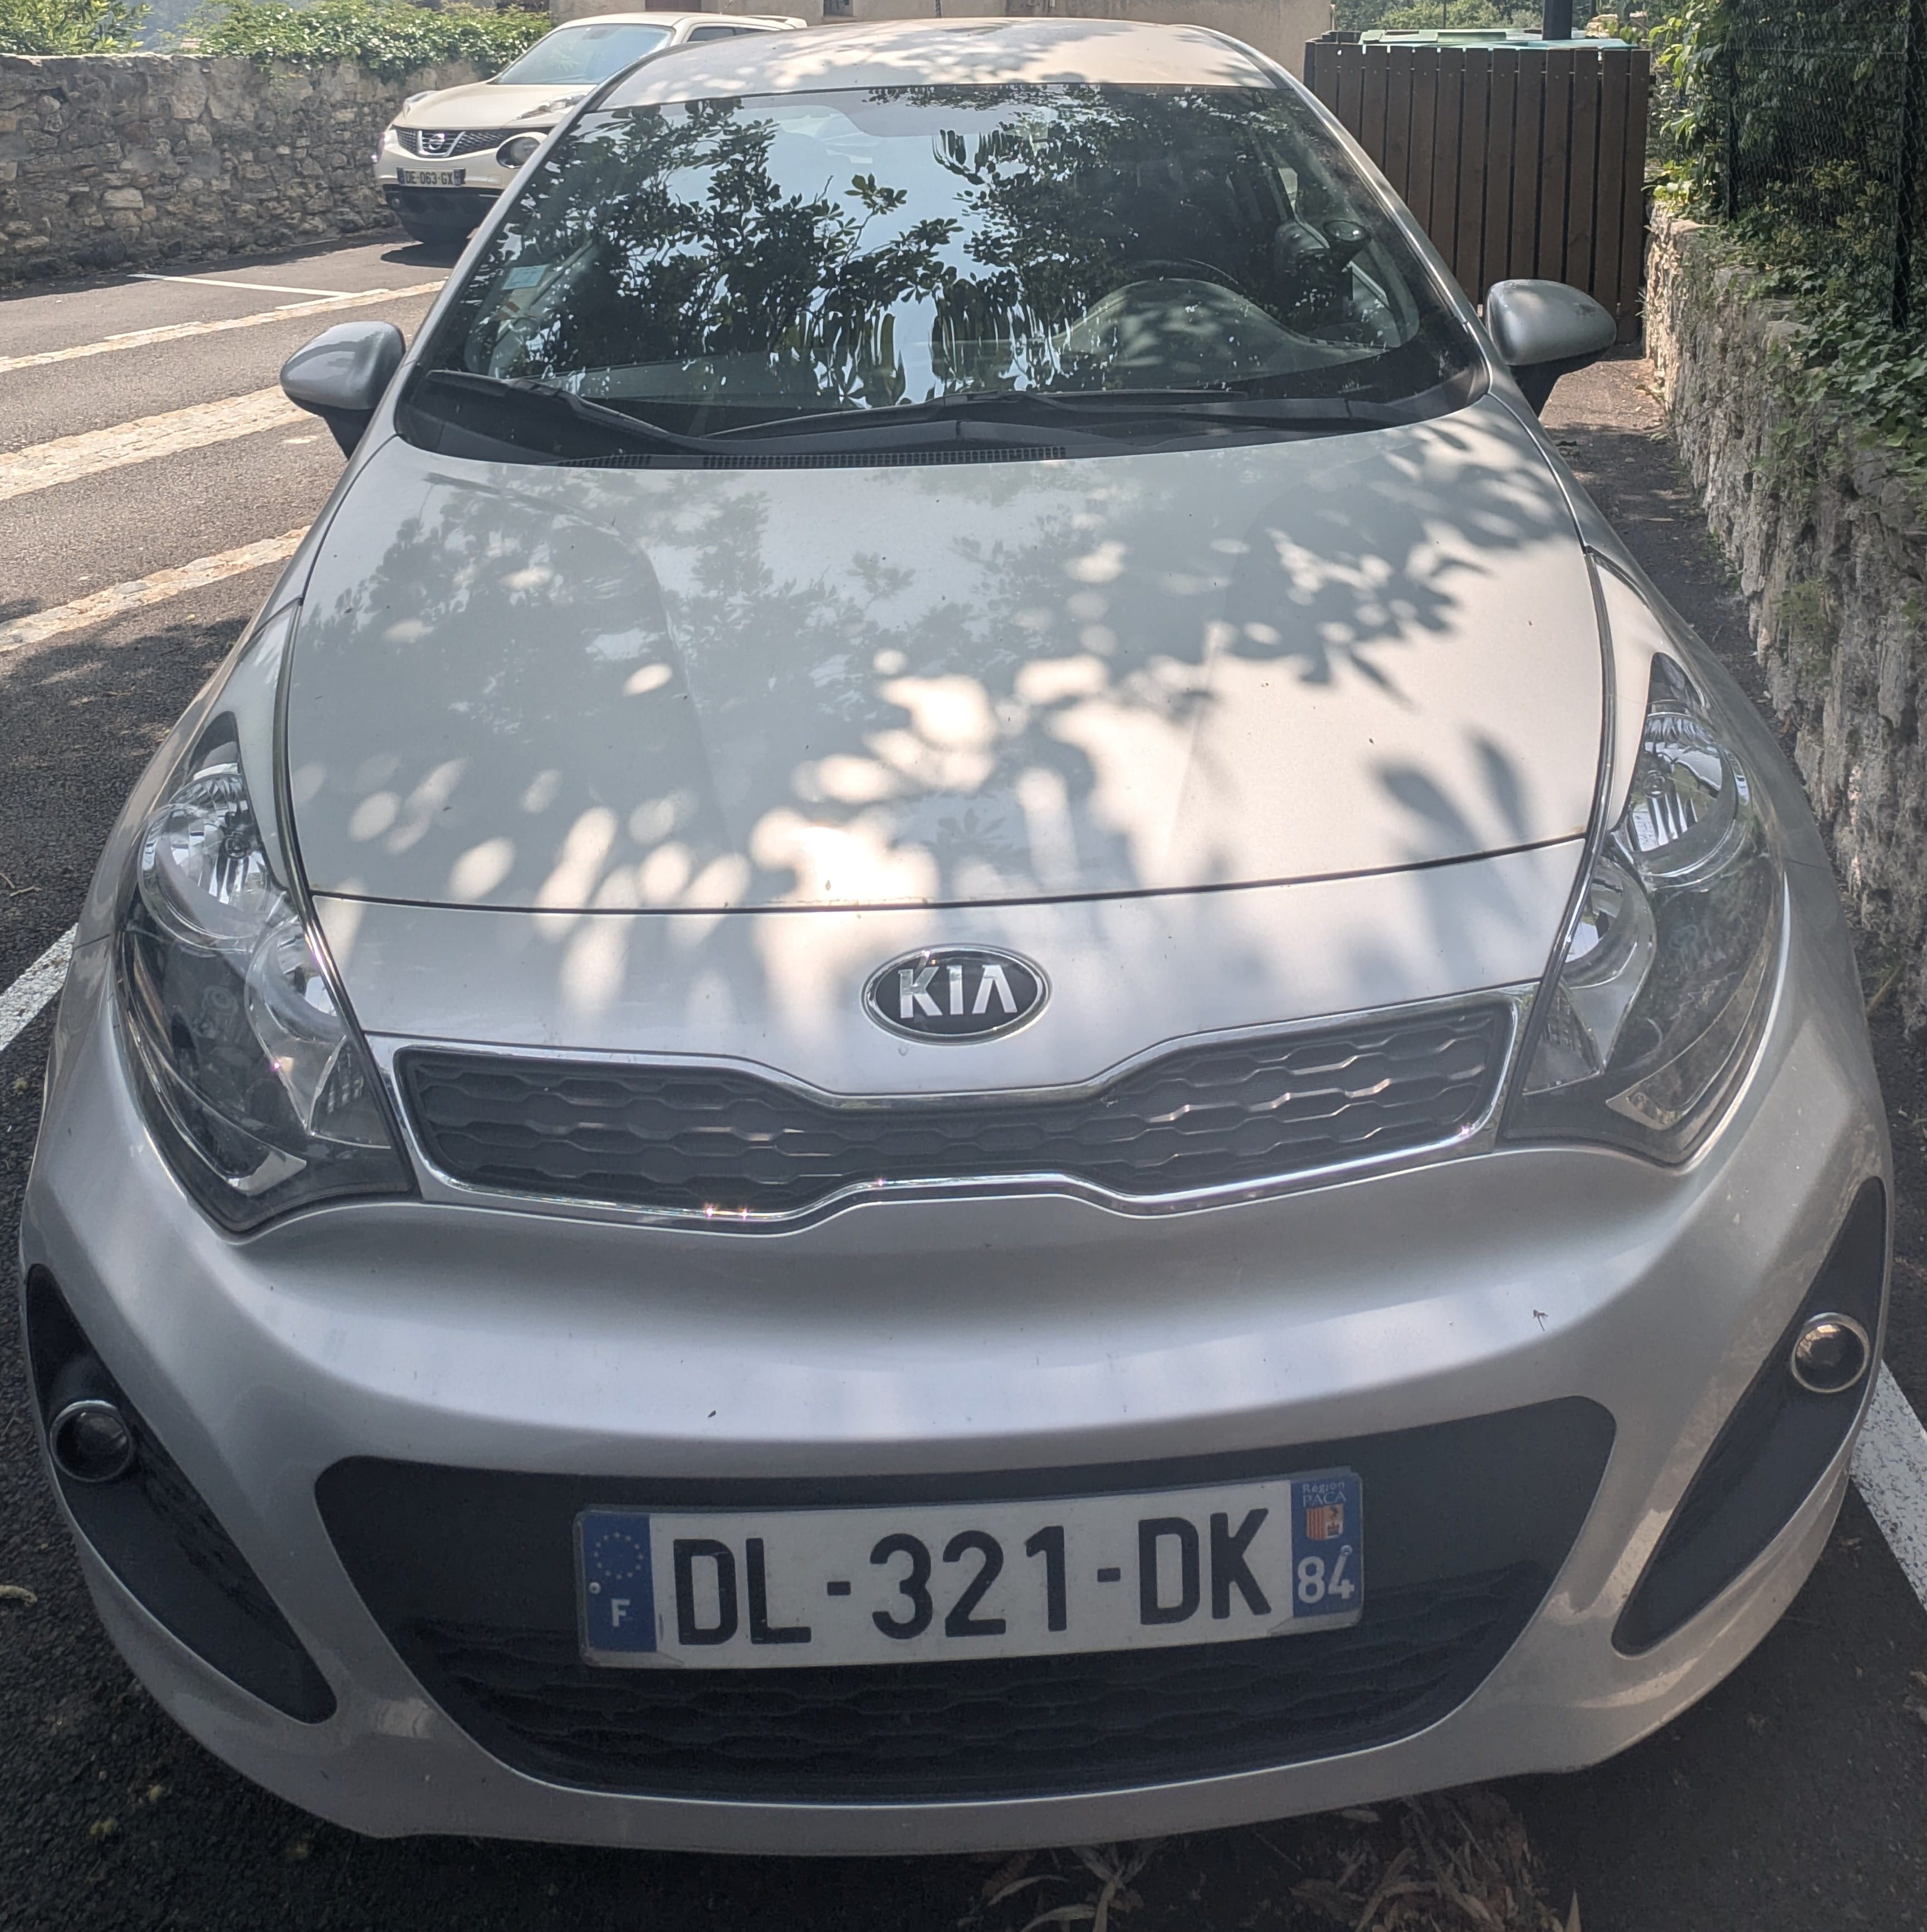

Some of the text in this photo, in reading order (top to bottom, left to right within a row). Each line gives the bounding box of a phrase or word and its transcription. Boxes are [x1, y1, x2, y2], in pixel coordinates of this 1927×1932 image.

[898, 965, 1018, 1019] KIA
[1303, 1491, 1347, 1507] PACA
[673, 1508, 1272, 1645] DL-321-DK
[1298, 1551, 1354, 1603] 84
[611, 1598, 630, 1627] F
